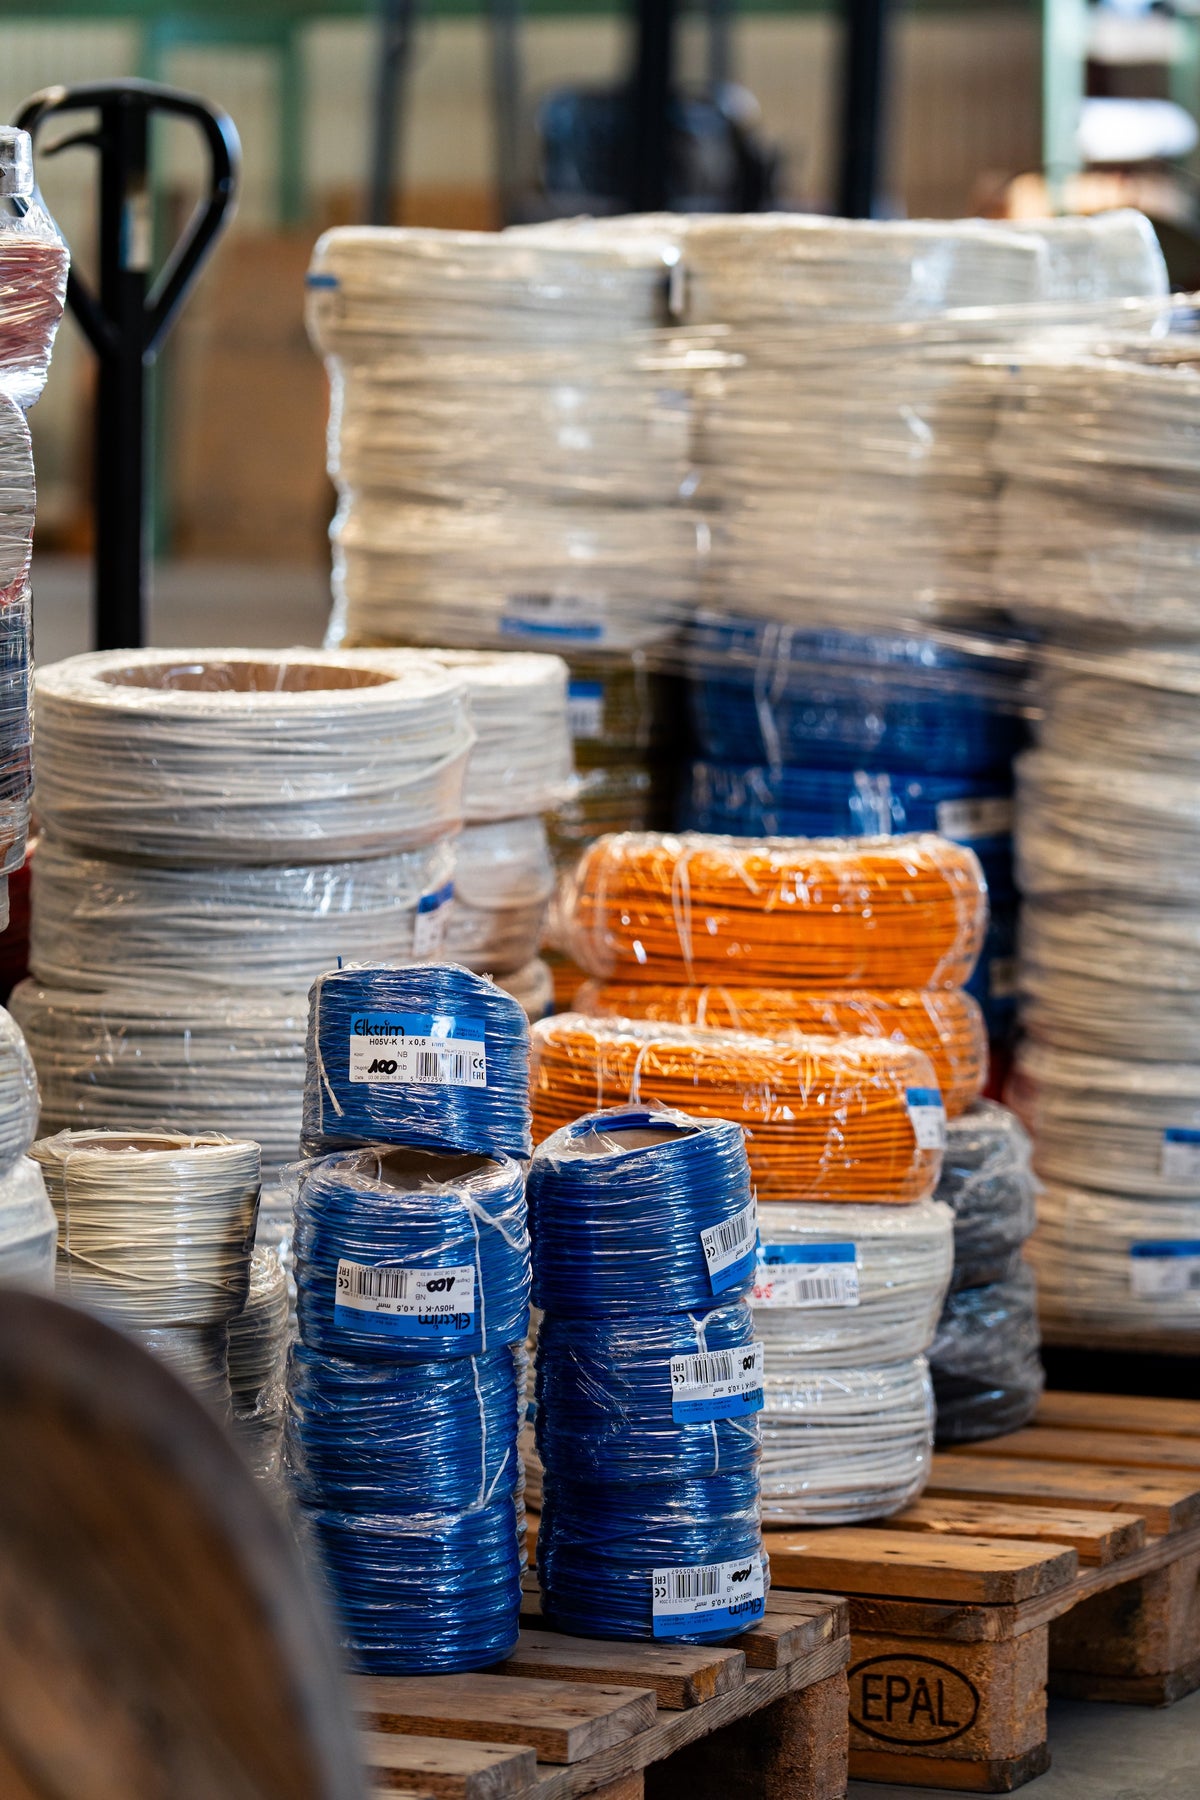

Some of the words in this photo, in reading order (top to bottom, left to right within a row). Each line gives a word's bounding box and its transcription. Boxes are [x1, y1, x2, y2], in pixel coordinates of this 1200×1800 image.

[354, 1019, 405, 1037] Elktrim
[369, 1038, 398, 1046] H05V-K
[401, 1038, 405, 1046] 1
[414, 1038, 426, 1047] 0,5
[367, 1058, 398, 1075] 100
[426, 1276, 456, 1292] 100
[396, 1305, 409, 1313] 0,5
[425, 1304, 455, 1312] H05V-K
[418, 1312, 471, 1330] Elktrim
[742, 1352, 756, 1371] 100
[727, 1385, 737, 1393] 0,5
[697, 1565, 718, 1573] 901259
[731, 1564, 752, 1582] 100
[711, 1599, 721, 1608] 0,5
[729, 1597, 762, 1617] Elktrim
[862, 1673, 960, 1728] EPAL
